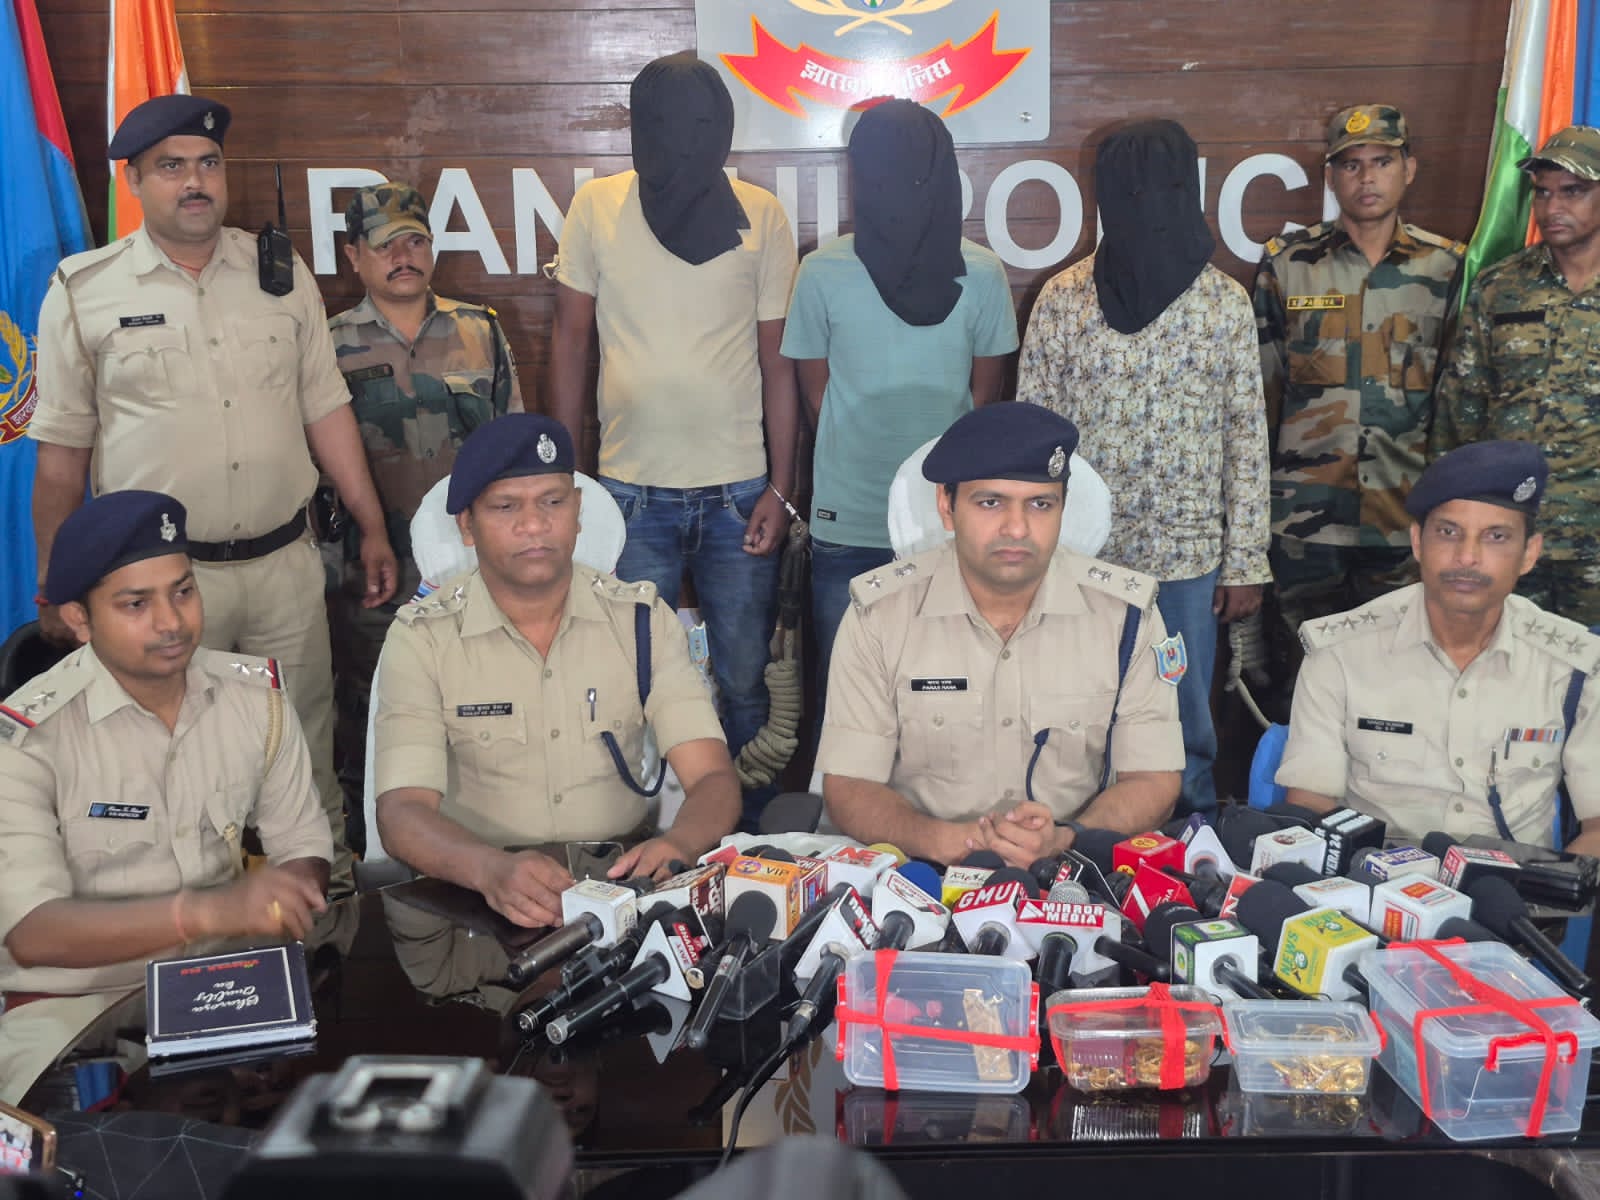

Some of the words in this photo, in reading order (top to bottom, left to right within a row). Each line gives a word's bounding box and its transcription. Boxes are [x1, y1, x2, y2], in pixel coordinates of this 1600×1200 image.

[306, 166, 840, 275] RANI
[765, 866, 790, 876] VIP
[958, 885, 1013, 910] GMU
[1042, 902, 1105, 916] MIRROR
[1046, 912, 1097, 925] MEDIA
[678, 924, 699, 962] BHARAT
[1280, 930, 1299, 976] NEWS
